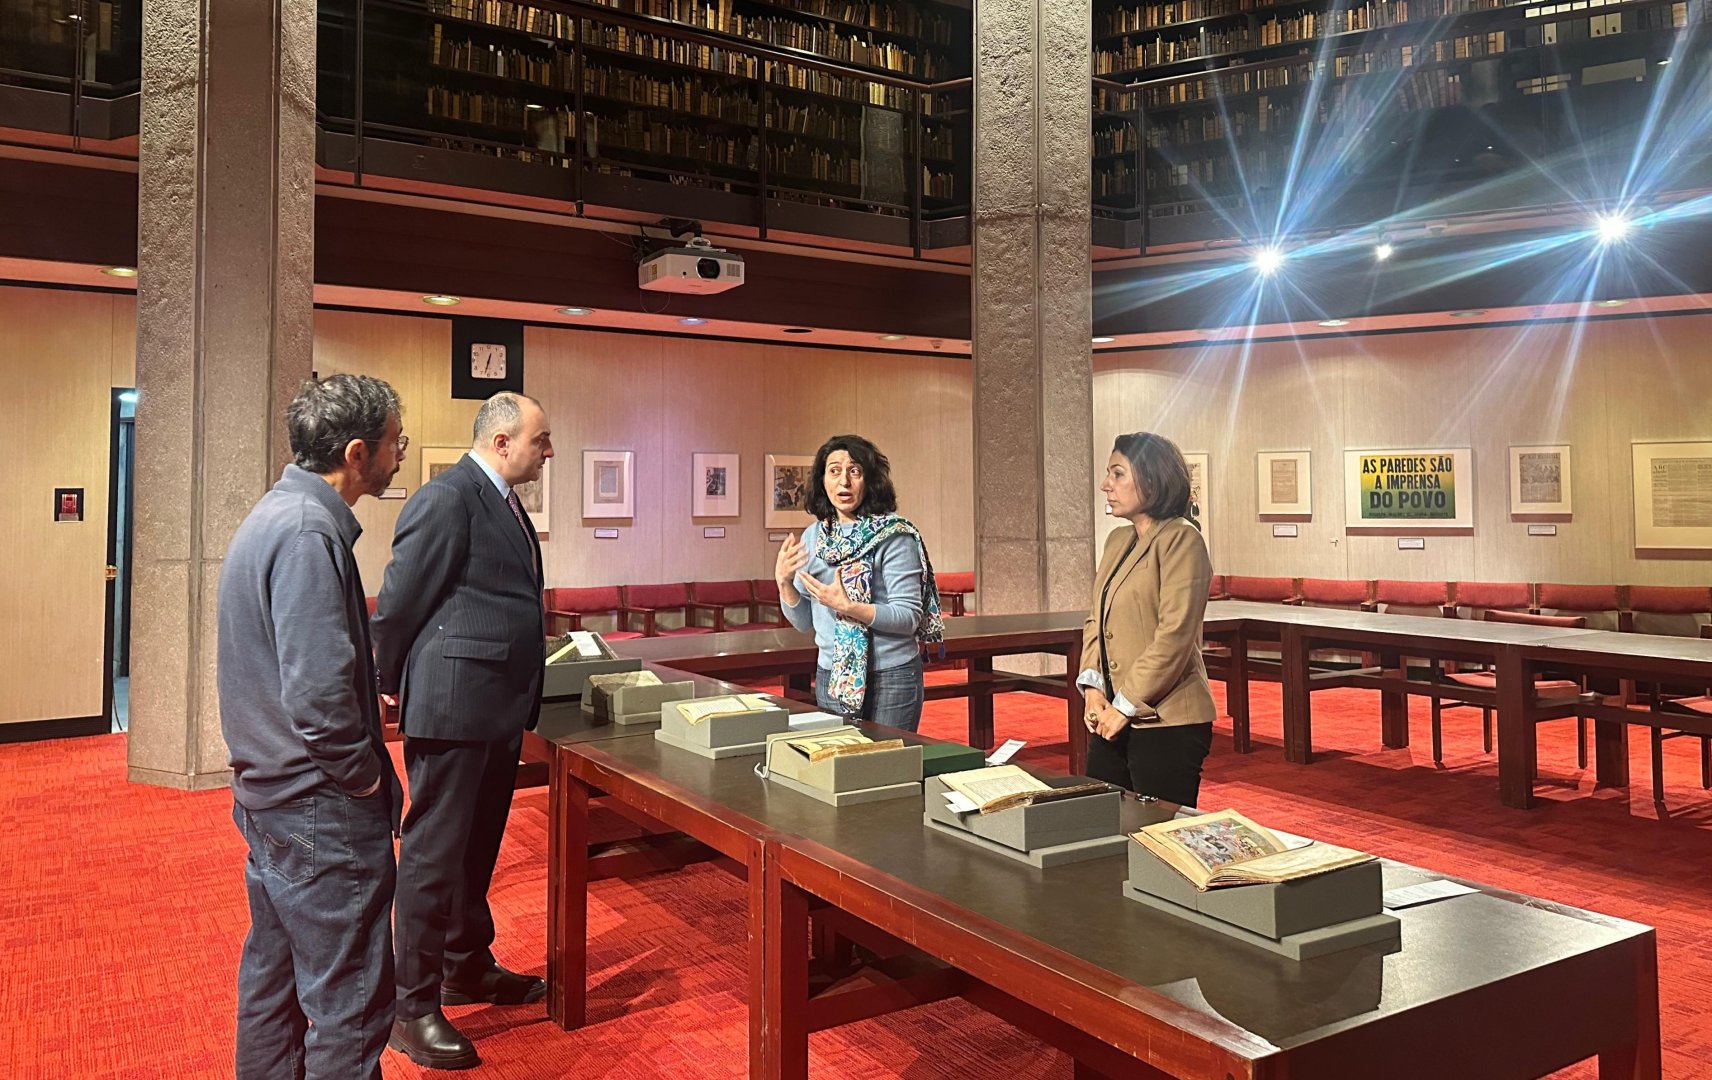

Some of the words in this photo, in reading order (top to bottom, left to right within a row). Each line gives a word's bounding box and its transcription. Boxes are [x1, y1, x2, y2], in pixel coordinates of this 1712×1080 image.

[1363, 459, 1376, 473] AS
[1380, 458, 1426, 473] PAREDES
[1430, 456, 1452, 472] SÃO
[1375, 475, 1382, 489] A
[1387, 474, 1440, 489] IMPRENSA
[1370, 491, 1393, 509] DO
[1399, 491, 1446, 509] POVO
